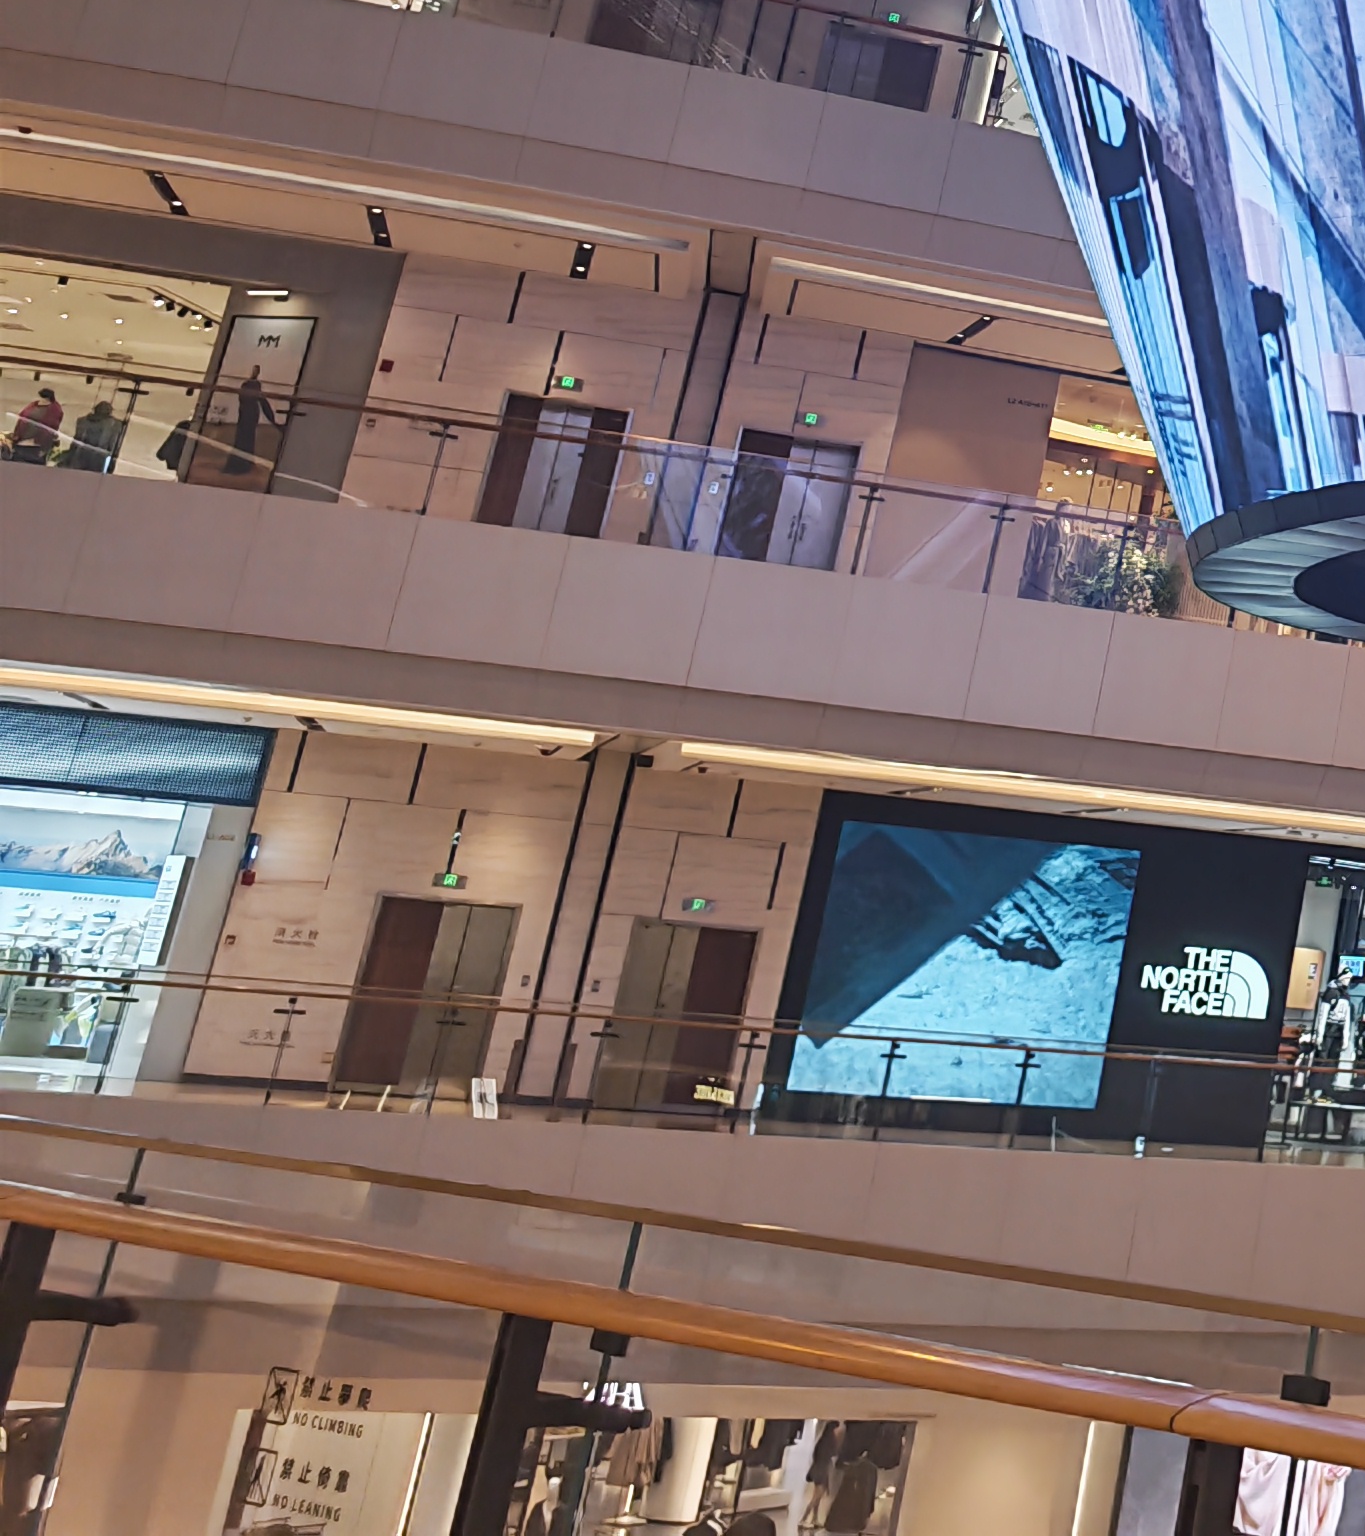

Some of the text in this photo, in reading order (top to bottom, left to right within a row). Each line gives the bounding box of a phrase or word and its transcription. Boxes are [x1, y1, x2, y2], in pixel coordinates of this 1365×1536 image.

[1184, 946, 1233, 972] THE
[1140, 964, 1228, 993] NORTH
[1161, 989, 1225, 1015] FACE
[292, 1412, 364, 1439] NO CLIMBING
[272, 1493, 342, 1522] NO LEANING
